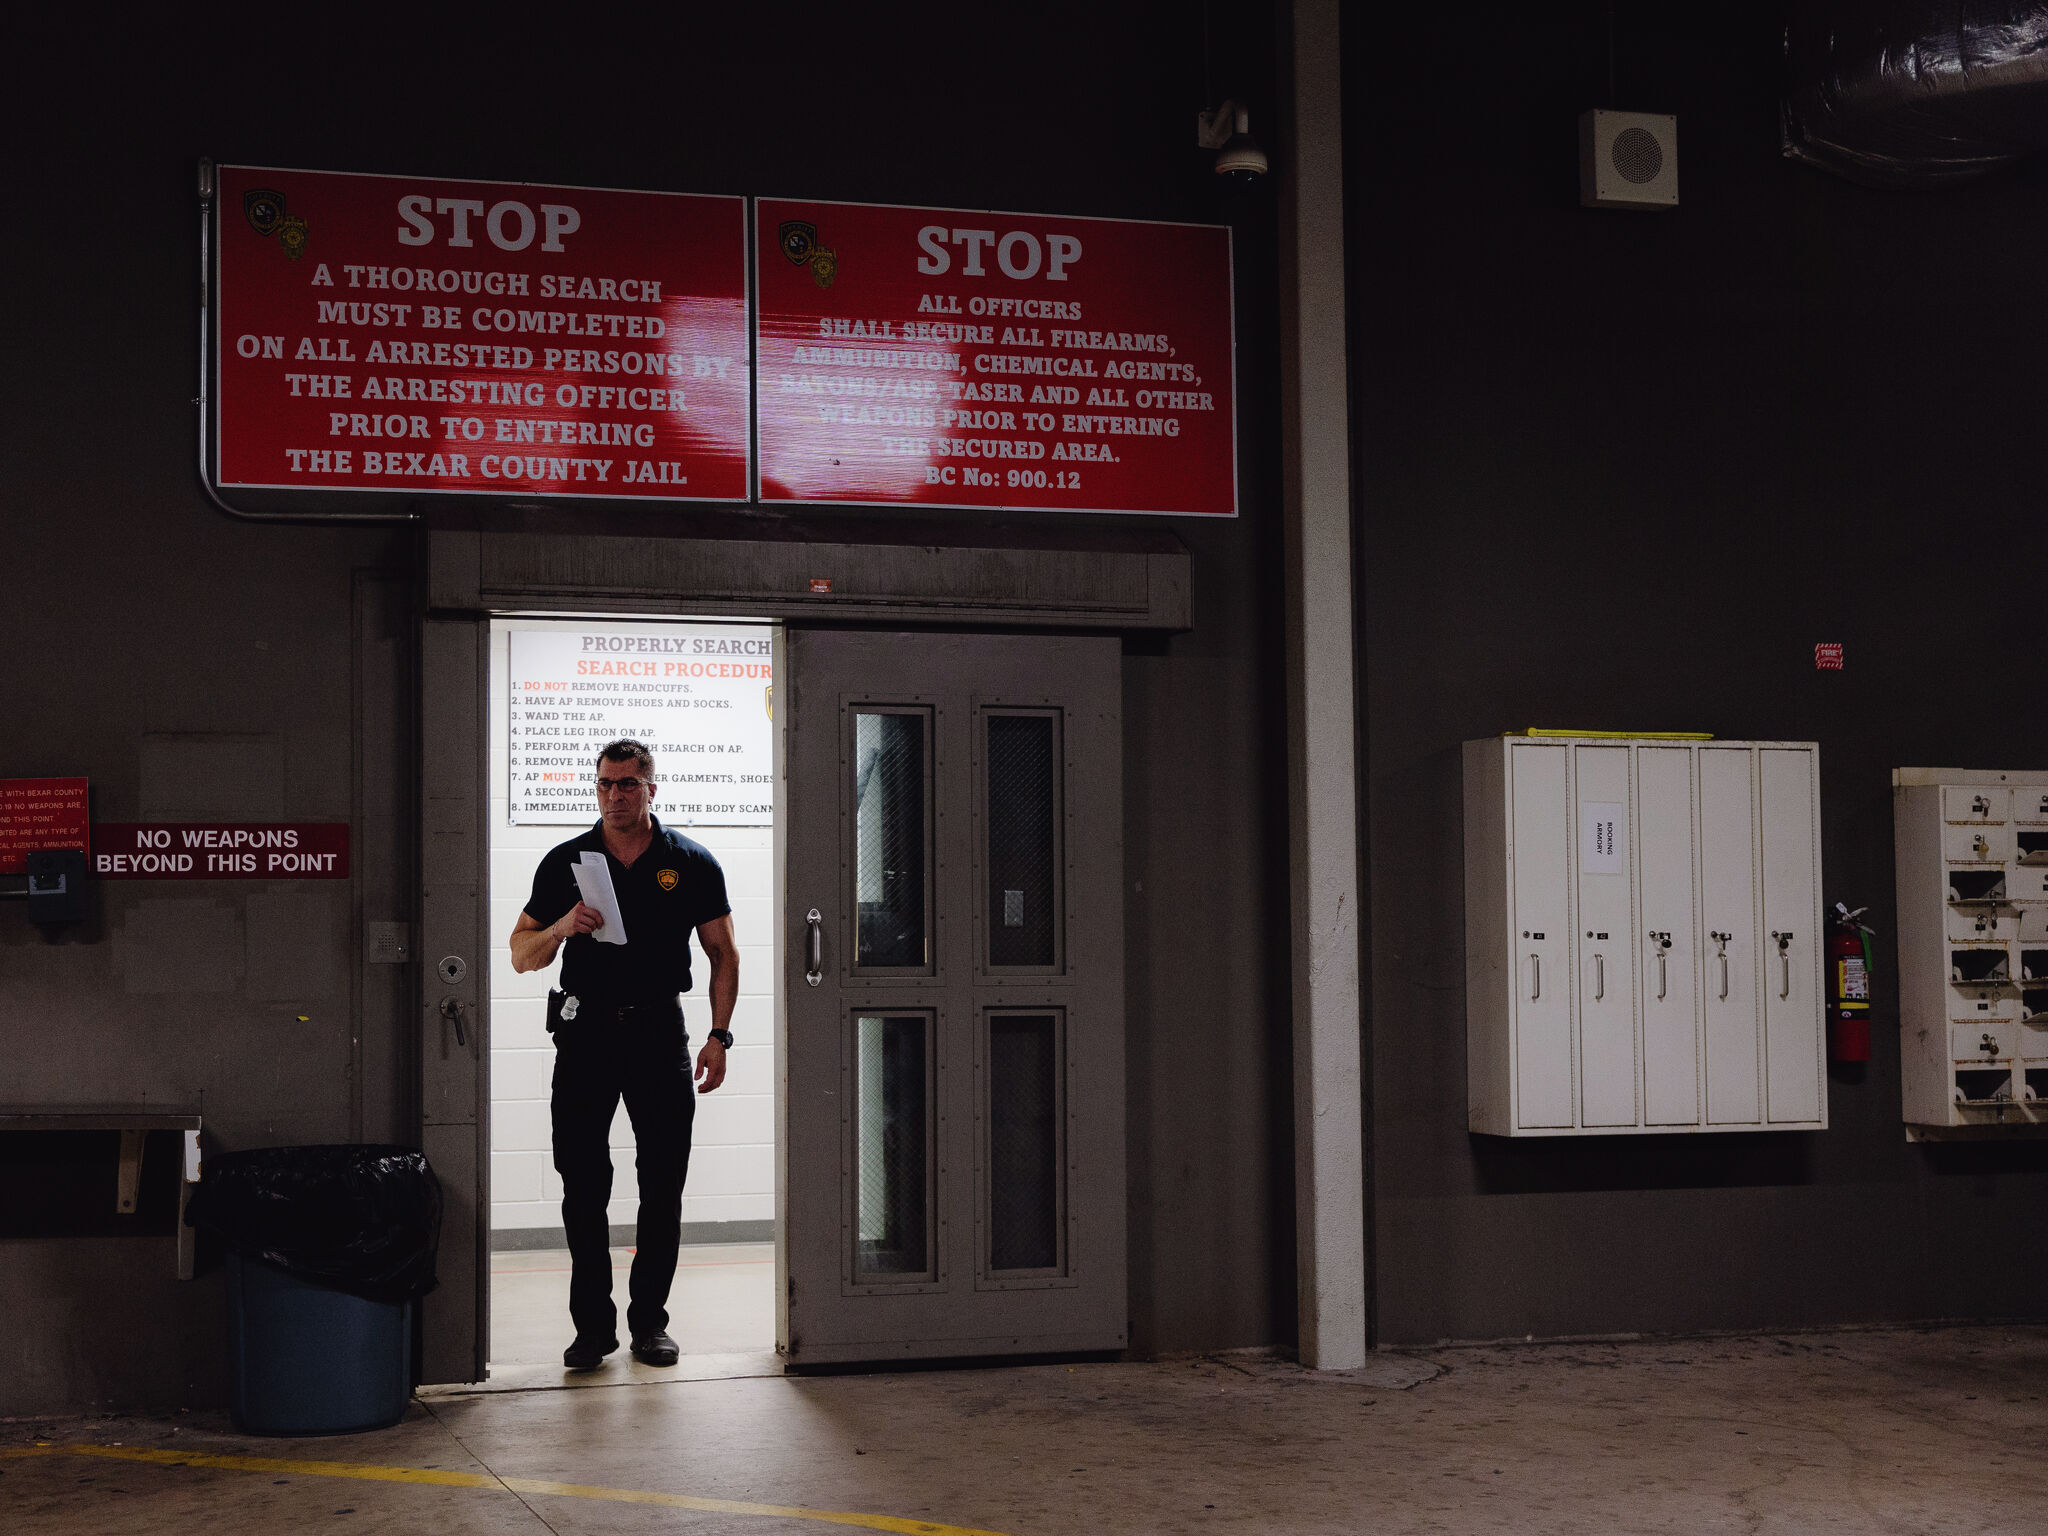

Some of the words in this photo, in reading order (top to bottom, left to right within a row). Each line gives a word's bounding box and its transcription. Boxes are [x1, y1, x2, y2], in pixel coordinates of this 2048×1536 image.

[397, 196, 581, 252] STOP
[917, 225, 1082, 281] STOP
[311, 264, 334, 287] A
[344, 265, 529, 297] THOROUGH
[540, 276, 663, 303] SEARCH
[918, 295, 962, 314] ALL
[969, 298, 1082, 320] OFFICERS
[317, 301, 411, 328] MUST
[423, 306, 462, 330] BE
[472, 308, 665, 339] COMPLETED
[820, 319, 896, 340] SHALL
[903, 322, 994, 345] SECURE
[1000, 327, 1043, 347] ALL
[1051, 330, 1175, 356] FIREARMS,
[237, 335, 285, 359] ON
[295, 338, 355, 362] ALL
[368, 342, 533, 370] ARRESTED
[544, 349, 684, 376] PERSONS
[692, 355, 730, 379] BY
[792, 347, 967, 376] AMMUNITION,
[975, 355, 1098, 377] CHEMICAL
[1104, 361, 1202, 386] AGENTS,
[285, 373, 352, 398] THE
[362, 377, 545, 406] ARRESTING
[556, 385, 688, 411] OFFICER
[948, 383, 1024, 404] TASER
[1031, 386, 1080, 405] AND
[1086, 388, 1129, 407] ALL
[1136, 390, 1214, 412] OTHER
[329, 414, 431, 438] PRIOR
[440, 417, 484, 441] TO
[495, 419, 654, 447] ENTERING
[817, 405, 936, 429] WEAPONS
[943, 410, 1017, 431] PRIOR
[1023, 413, 1055, 432] TO
[1063, 415, 1180, 438] ENTERING
[937, 440, 1045, 460] SECURED
[1051, 444, 1120, 463] AREA.
[286, 449, 352, 473] THE
[362, 452, 471, 478] BEXAR
[480, 455, 612, 482] COUNTY
[622, 461, 687, 485] JAIL
[925, 468, 955, 485] BC
[963, 469, 1000, 487] No:
[1007, 469, 1080, 490] 900.12
[582, 636, 686, 653] PROPERLY
[693, 639, 771, 654] SEARCH
[577, 661, 656, 676] SEARCH
[664, 662, 772, 678] PROCEDUR
[512, 682, 520, 690] 1.
[524, 682, 540, 690] DO
[544, 682, 568, 691] NOT
[572, 683, 619, 692] REMOVE
[622, 684, 693, 693] HANDCUFFS.
[512, 697, 521, 705] 2.
[525, 697, 554, 706] HAVE
[558, 698, 573, 706] AP
[576, 698, 624, 706] REMOVE
[628, 698, 663, 707] SHOES
[667, 699, 690, 708] AND
[694, 700, 732, 709] SOCKS.
[512, 712, 521, 720] 3.
[525, 712, 559, 720] WAND
[563, 712, 586, 721] THE
[590, 713, 605, 721] AP.
[512, 727, 521, 735] 4.
[525, 727, 560, 736] PLACE
[564, 728, 585, 736] LEG
[588, 728, 617, 736] IRON
[620, 728, 636, 737] ON
[640, 729, 656, 737] AP.
[512, 742, 521, 750] 5.
[525, 742, 580, 751] PERFORM
[583, 743, 590, 751] A
[662, 744, 705, 753] SEARCH
[709, 744, 725, 753] ON
[728, 745, 744, 753] AP.
[512, 758, 521, 766] 6.
[525, 758, 573, 766] REMOVE
[512, 773, 521, 781] 7.
[525, 773, 540, 781] AP
[542, 773, 576, 782] MUST
[672, 774, 737, 784] GARMENTS,
[524, 788, 532, 796] A
[535, 788, 598, 796] SECONDAR
[512, 803, 520, 812] 8.
[525, 803, 598, 812] IMMEDIATEL
[664, 804, 677, 812] IN
[680, 804, 702, 812] THE
[706, 804, 737, 813] BODY
[740, 804, 773, 813] SCANN
[137, 830, 171, 848] NO
[182, 830, 298, 848] WEAPONS
[97, 854, 193, 872] BEYOND
[208, 854, 256, 871] THIS
[268, 854, 337, 871] POINT
